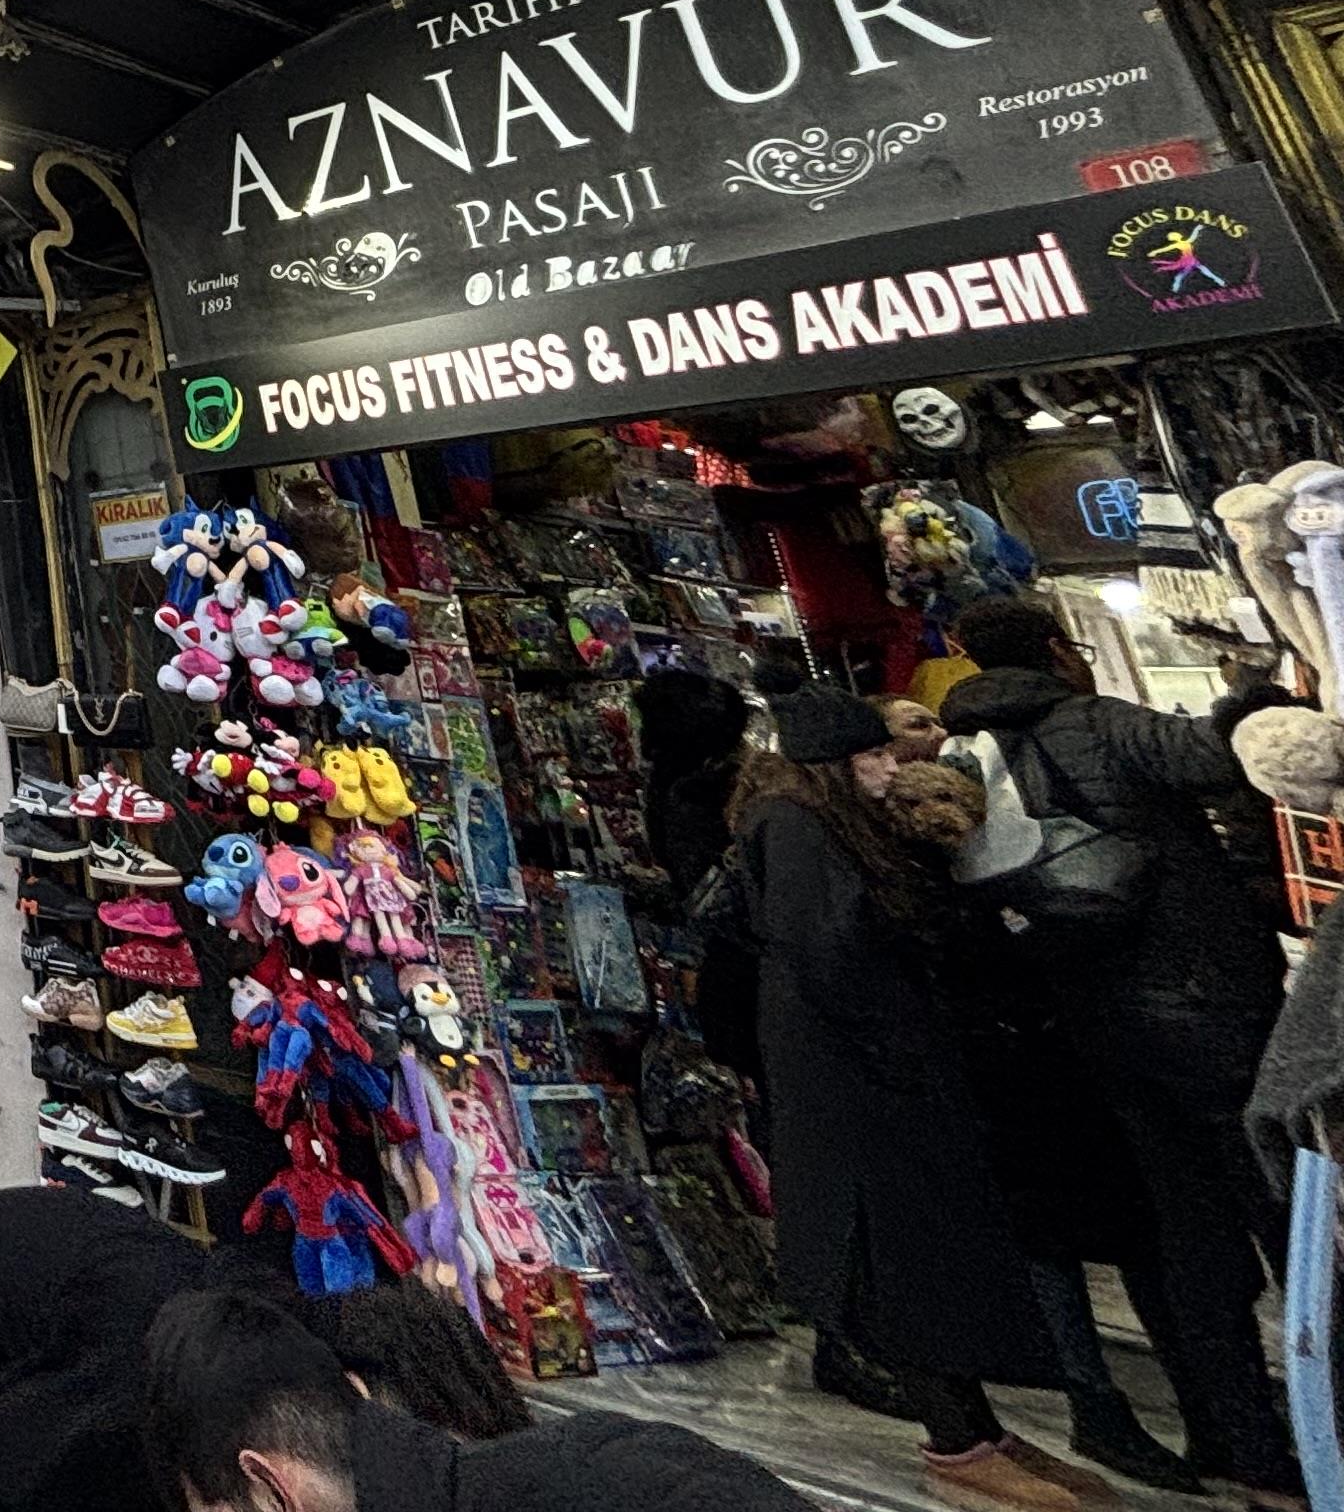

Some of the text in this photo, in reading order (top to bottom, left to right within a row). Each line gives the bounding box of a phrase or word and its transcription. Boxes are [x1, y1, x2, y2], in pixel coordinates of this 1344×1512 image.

[978, 65, 1148, 117] Restorasyon
[1037, 107, 1104, 139] 1993
[1109, 155, 1175, 187] 108
[1107, 206, 1249, 258] FOCUS DANS
[187, 273, 239, 295] Kuruluş
[464, 239, 698, 308] Old Bazaar
[201, 296, 232, 316] 1893
[258, 233, 1090, 434] FOCUS FITNESS & DANS AKADEMİ
[95, 496, 167, 525] KİRALIK
